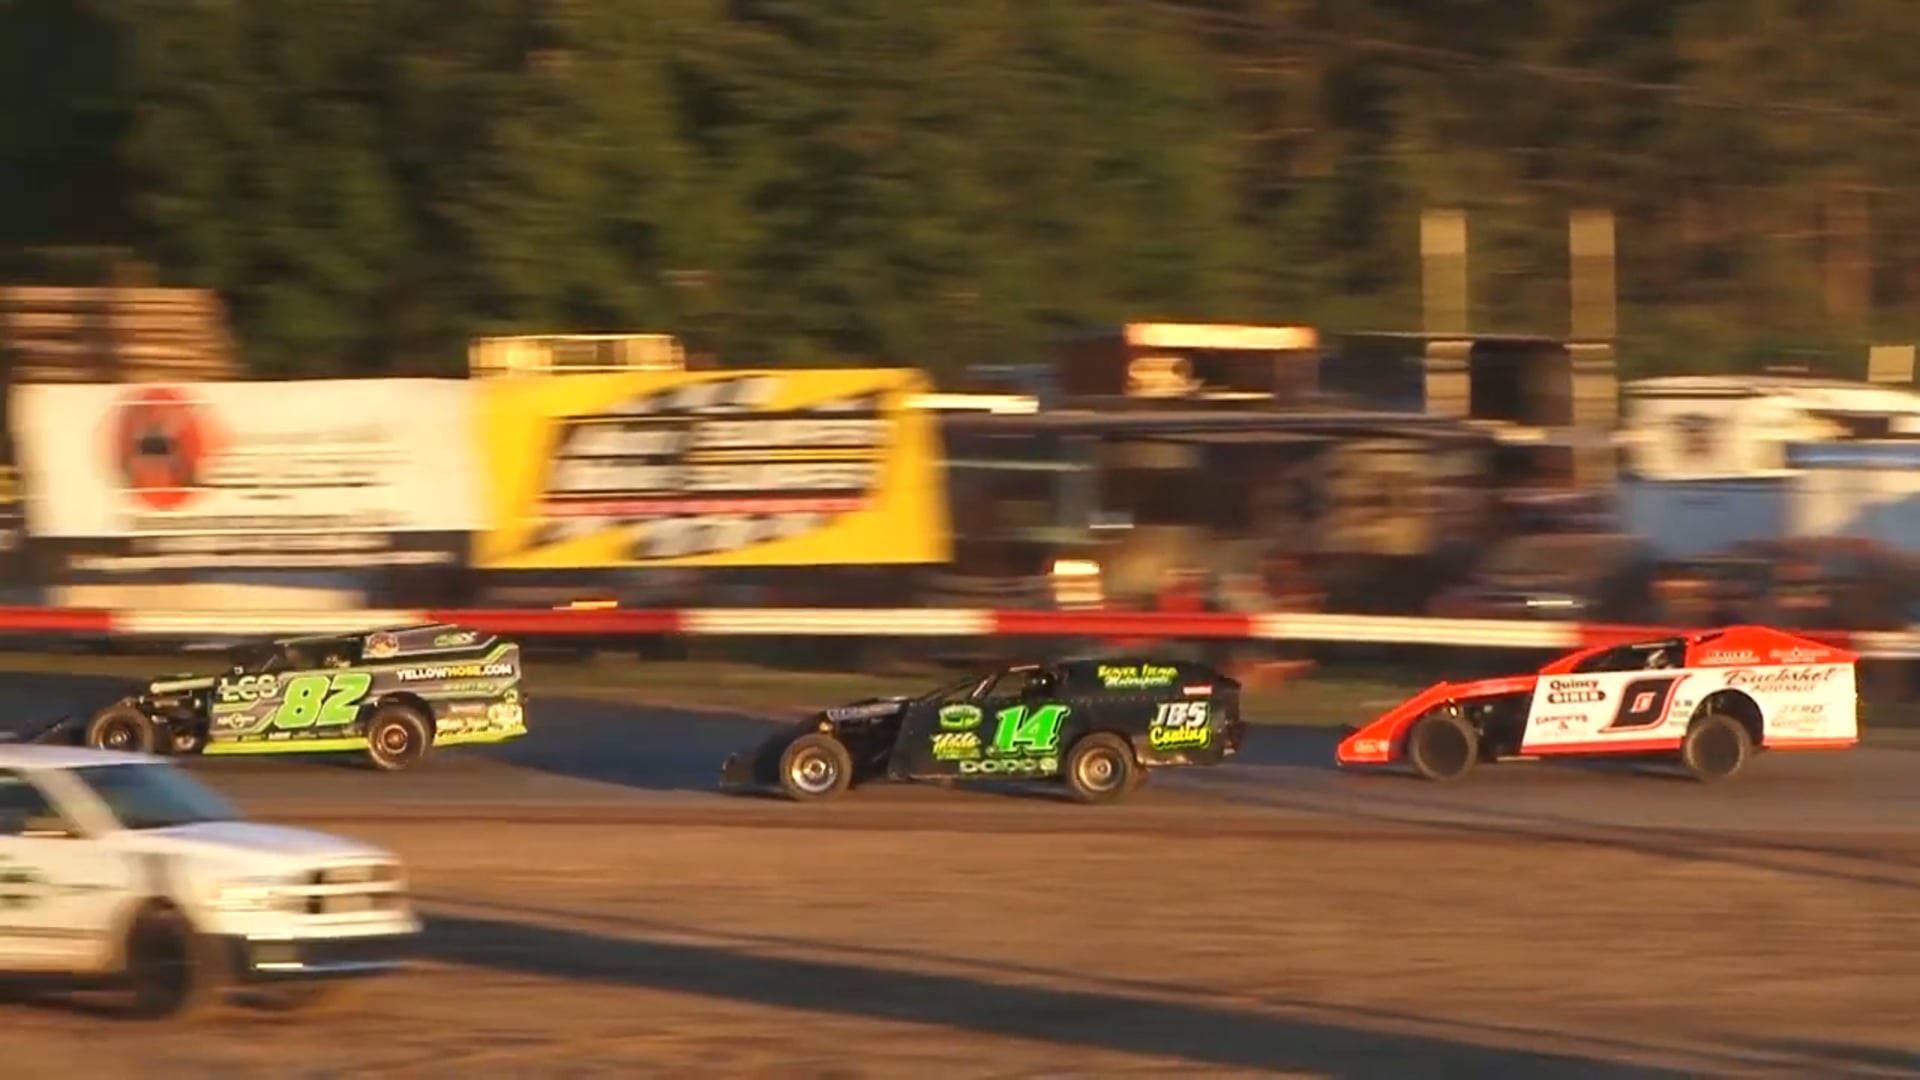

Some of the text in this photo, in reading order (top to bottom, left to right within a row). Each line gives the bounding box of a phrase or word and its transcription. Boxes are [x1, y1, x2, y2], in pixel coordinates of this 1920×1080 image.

[397, 664, 512, 681] YELLOWHOSE.COM
[1550, 679, 1599, 691] Quincy
[274, 672, 372, 729] 82
[1151, 702, 1207, 727] JBS
[996, 705, 1071, 754] 14
[1151, 724, 1209, 745] Coating
